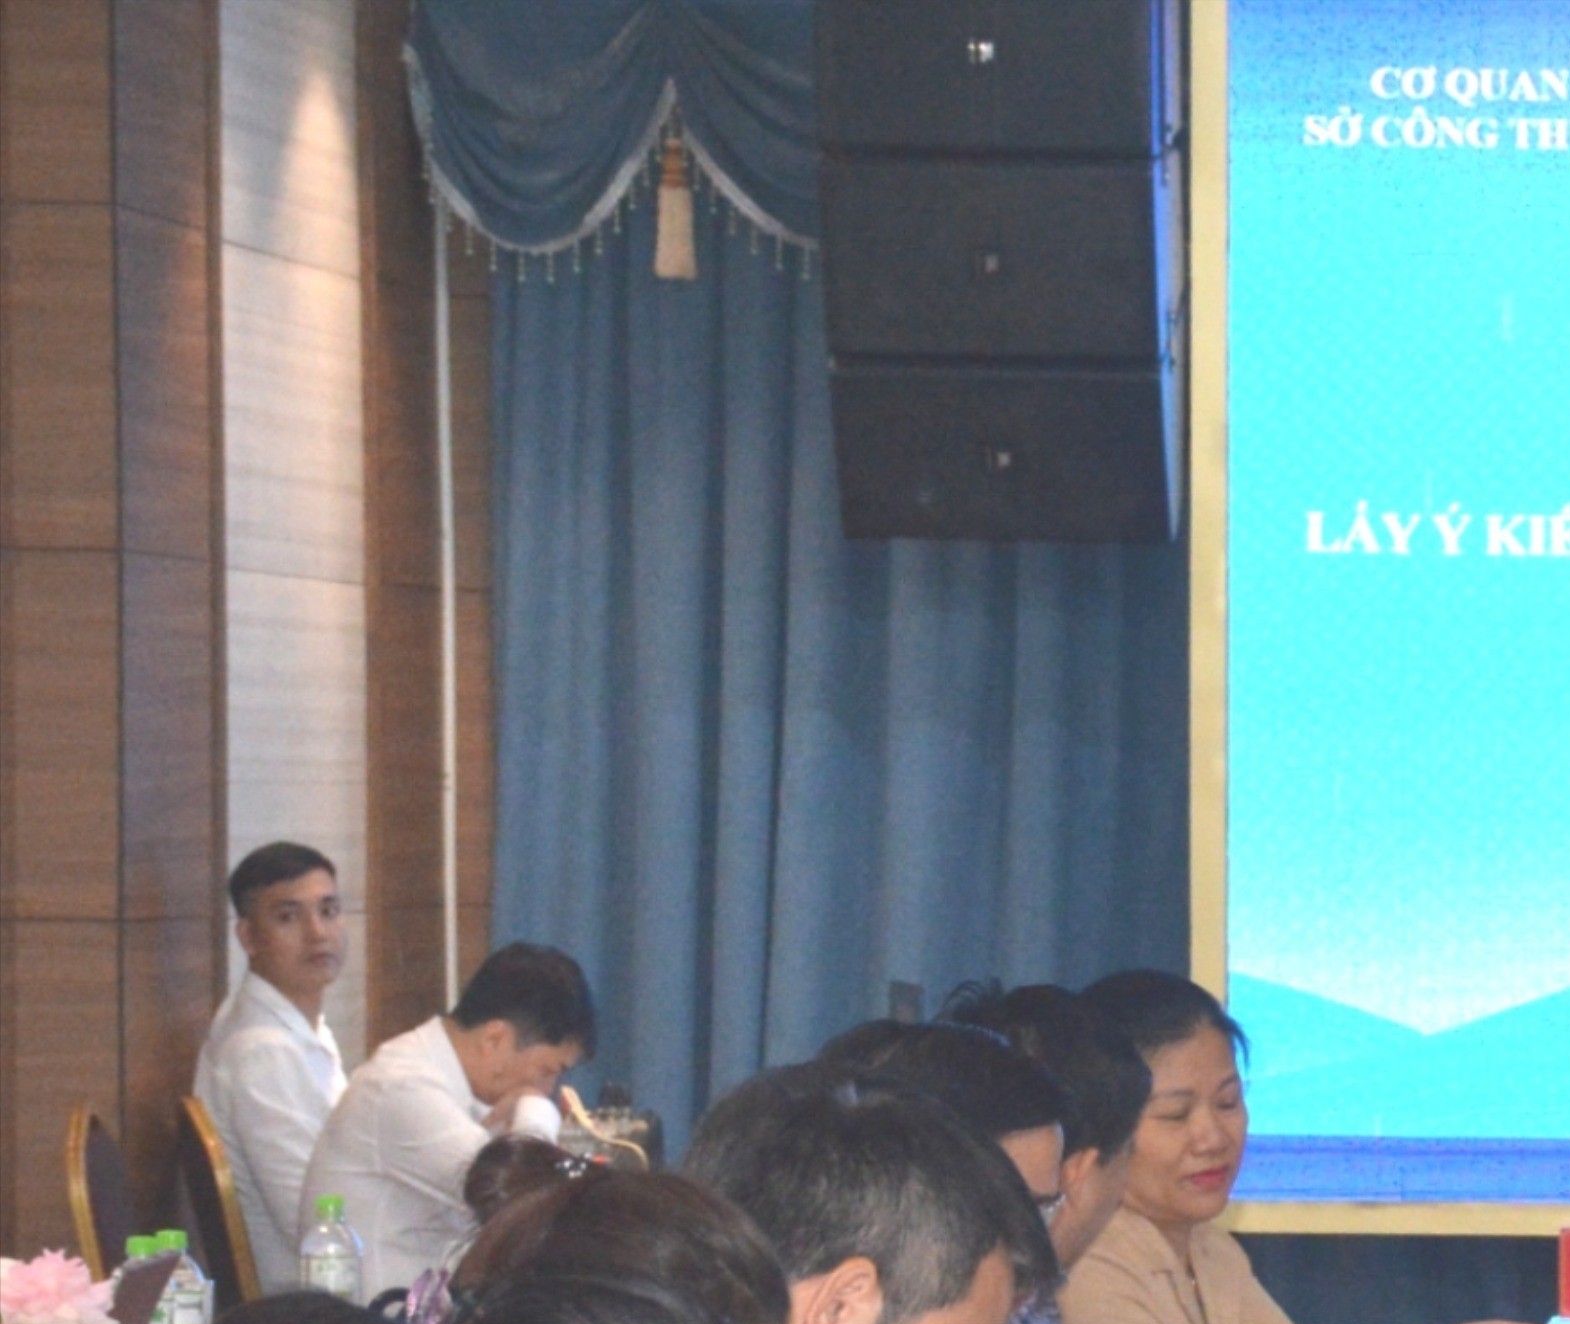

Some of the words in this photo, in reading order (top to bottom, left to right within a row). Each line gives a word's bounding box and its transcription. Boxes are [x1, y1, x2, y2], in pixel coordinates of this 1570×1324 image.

[1369, 65, 1438, 99] CƠ
[1443, 67, 1569, 108] QUAN
[1303, 105, 1364, 147] SỞ
[1370, 105, 1499, 149] CÔNG
[1432, 502, 1472, 557] Ý
